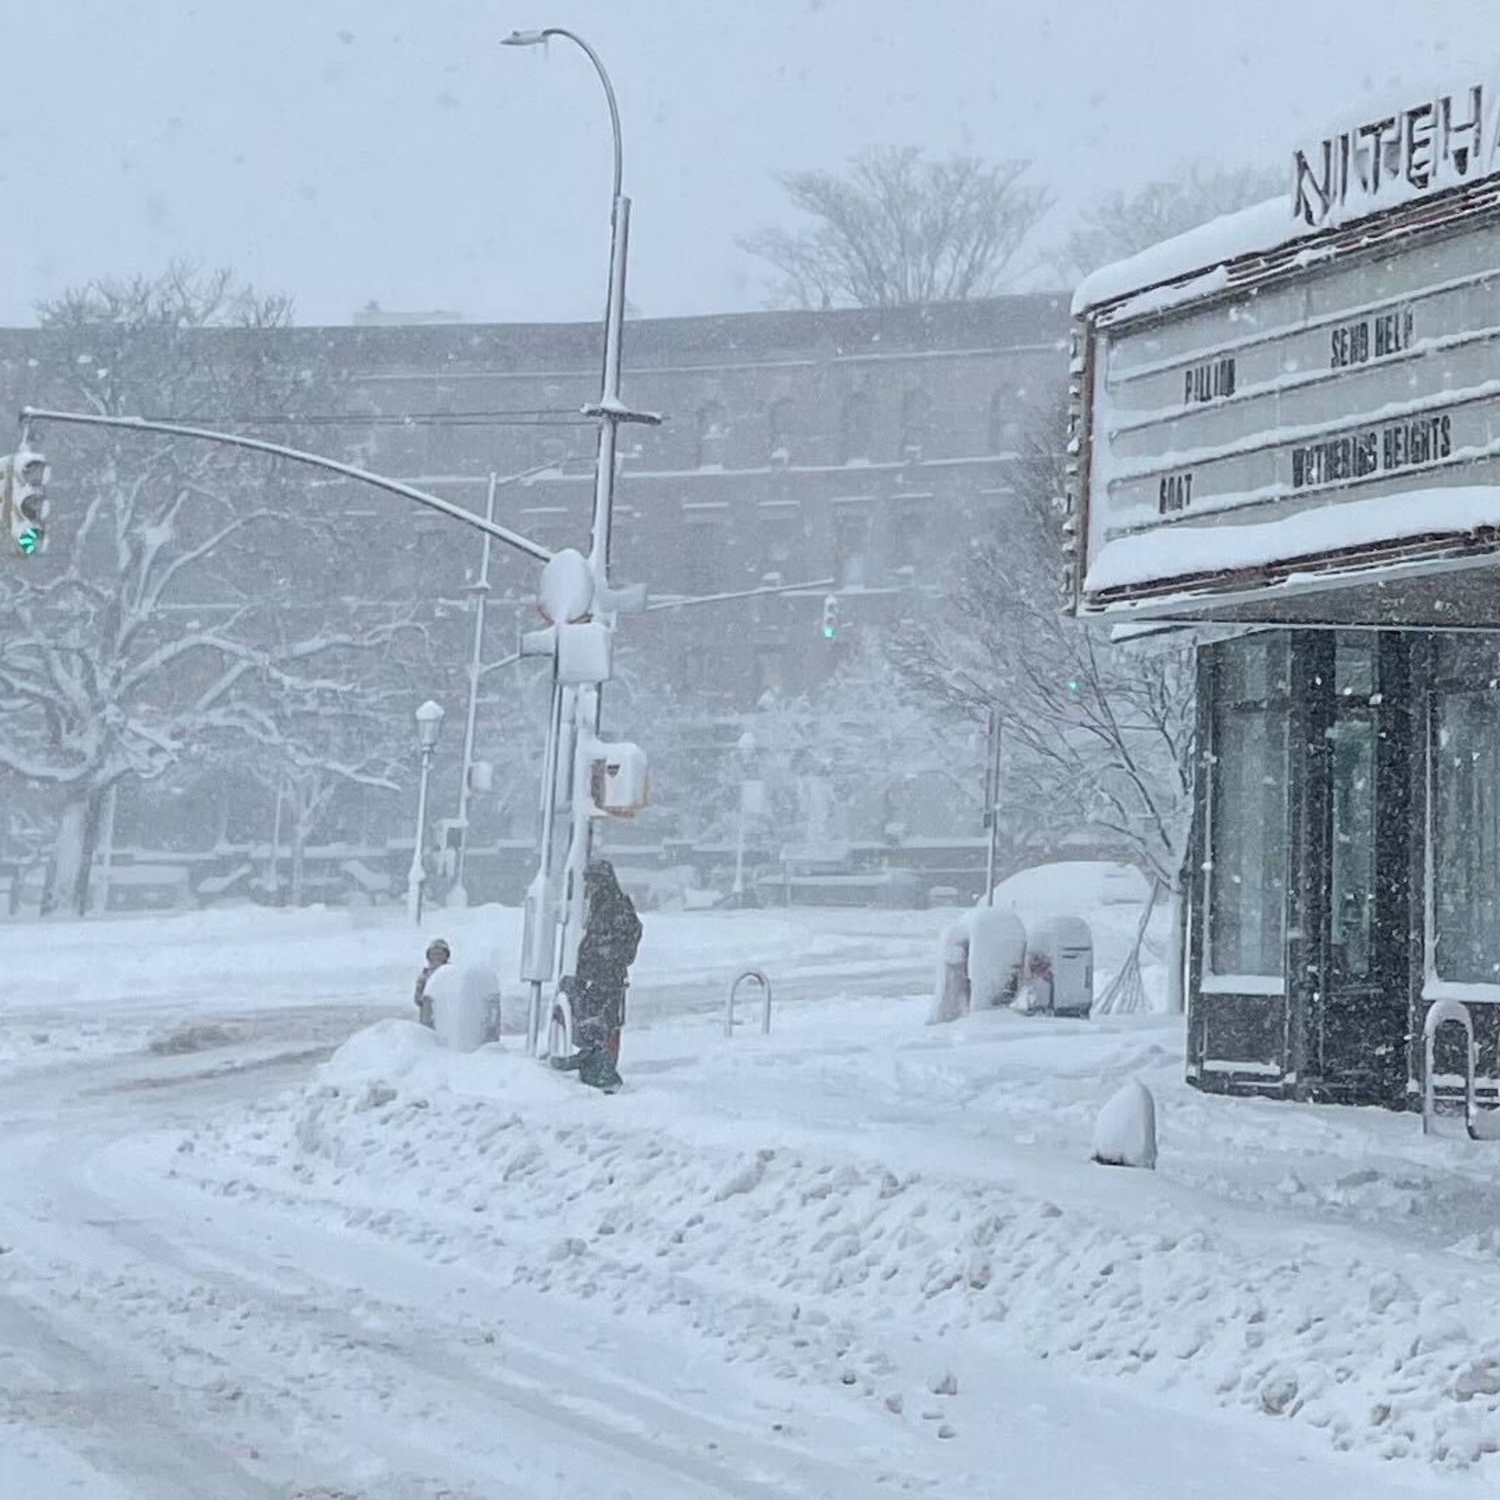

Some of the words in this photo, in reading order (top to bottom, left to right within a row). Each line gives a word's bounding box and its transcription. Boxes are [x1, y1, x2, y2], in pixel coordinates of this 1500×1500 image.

[1331, 321, 1369, 369] SEND
[1375, 308, 1414, 358] HELP
[1292, 432, 1378, 489] WUTHERING
[1383, 414, 1451, 470] HEIGHTS
